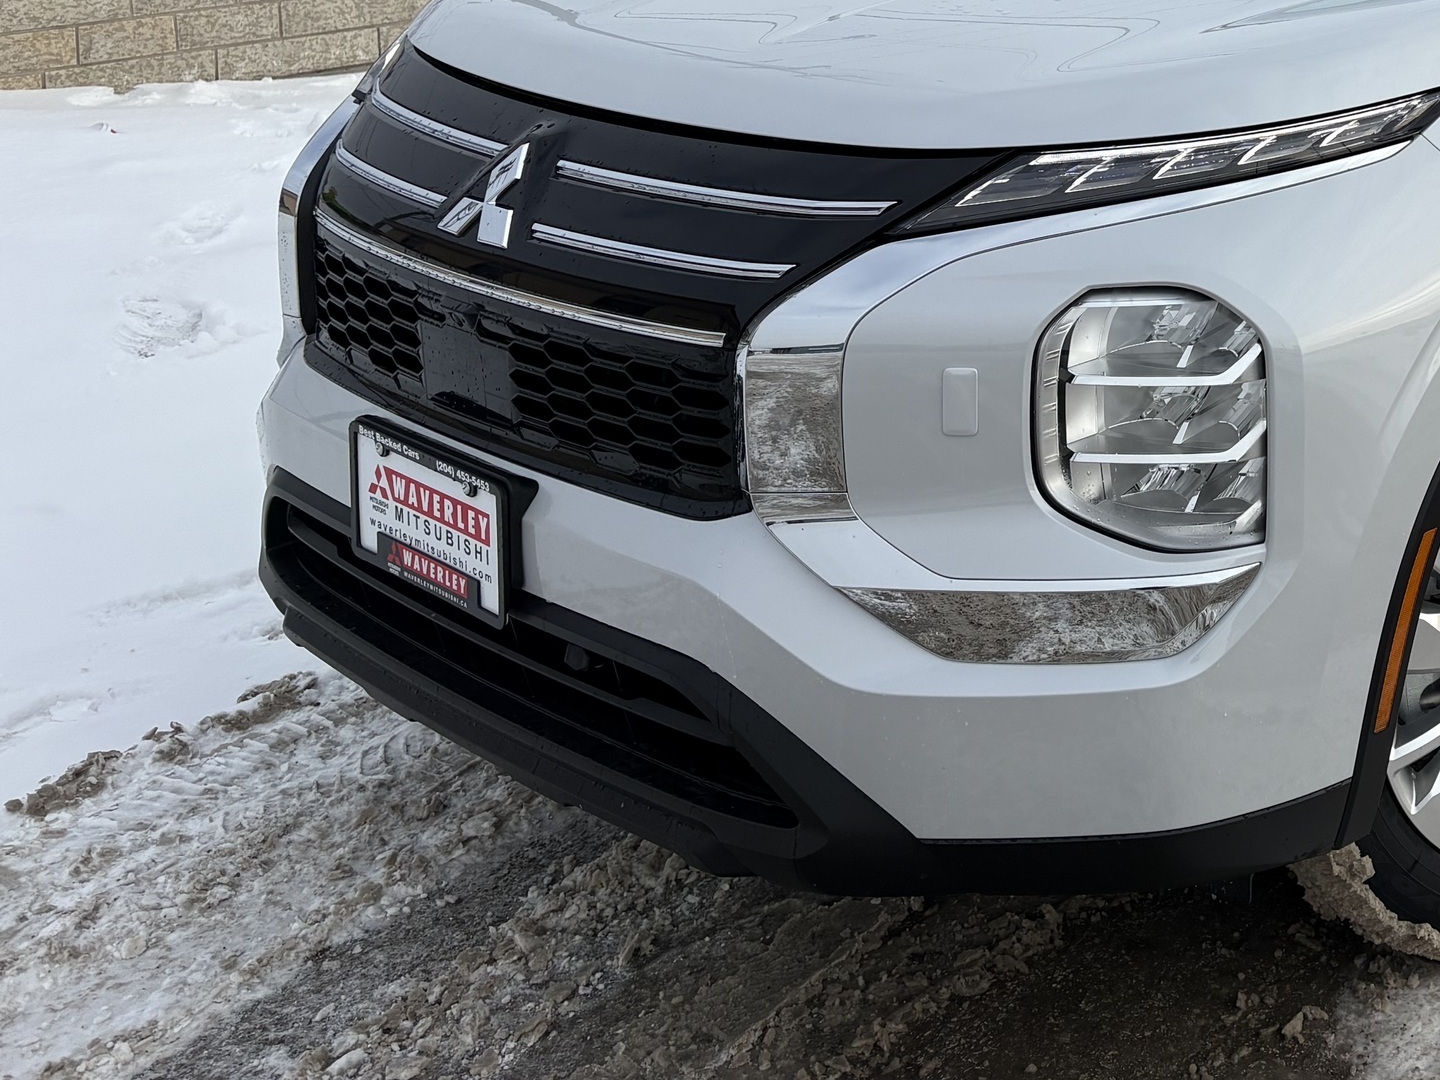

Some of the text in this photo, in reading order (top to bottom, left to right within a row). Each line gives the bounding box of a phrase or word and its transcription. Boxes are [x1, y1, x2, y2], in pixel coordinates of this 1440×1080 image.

[358, 424, 490, 492] Best Backed Cars (204) 453-5453
[391, 473, 490, 541] WAVERLEY
[394, 505, 490, 566] MITSUBISHI
[369, 516, 493, 585] waverleymitsubishi.com
[402, 548, 467, 595] WAVERLEY
